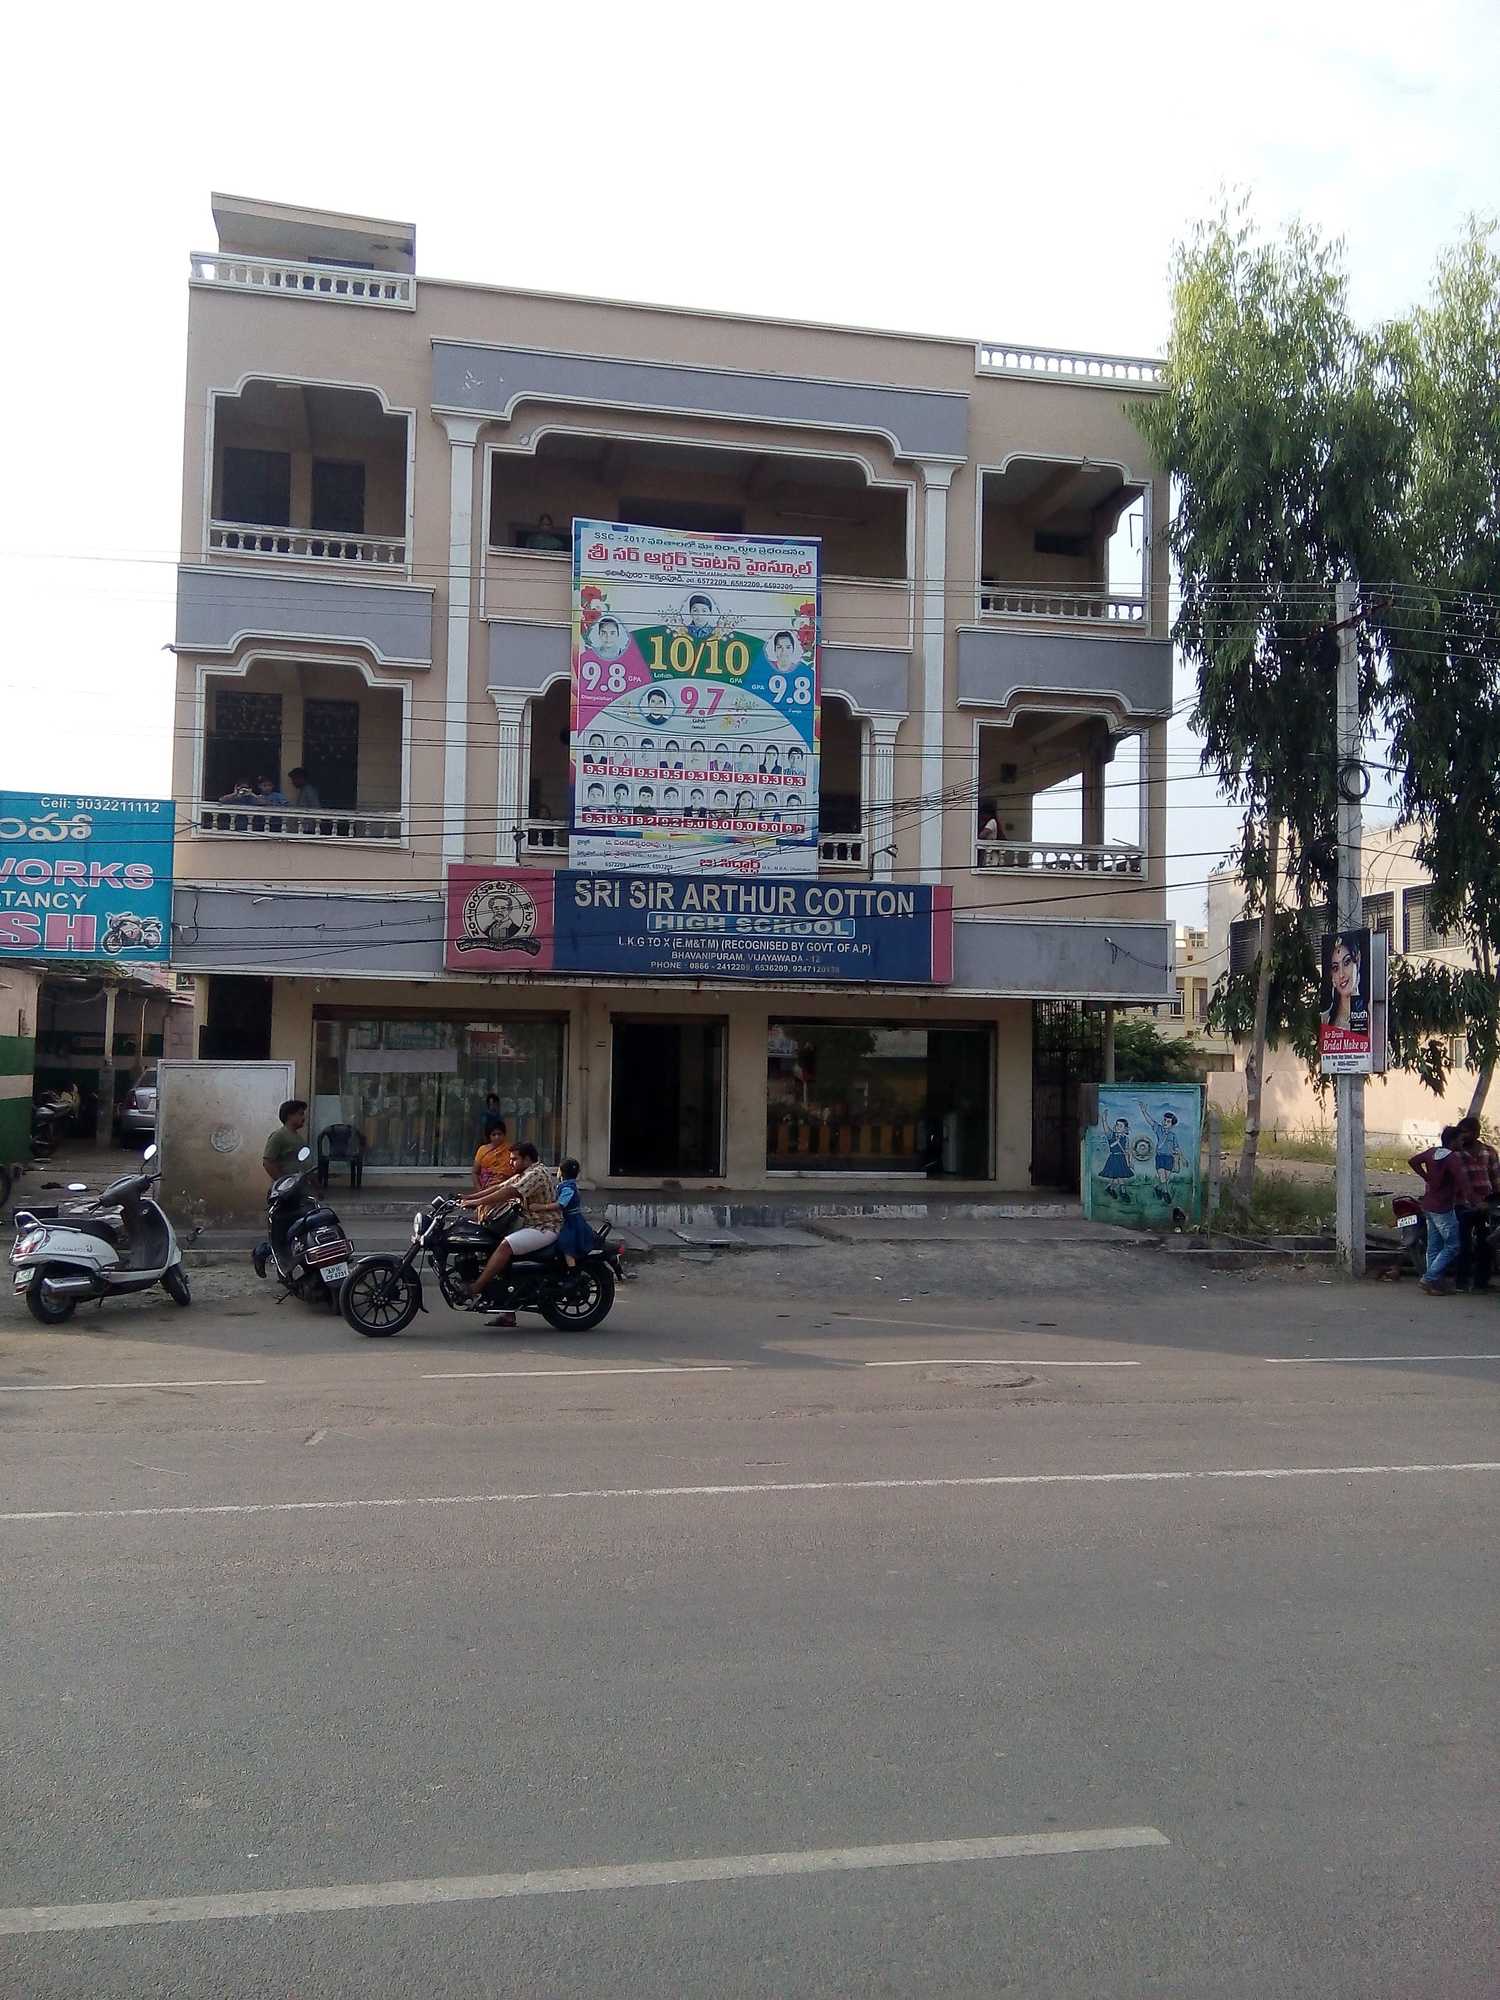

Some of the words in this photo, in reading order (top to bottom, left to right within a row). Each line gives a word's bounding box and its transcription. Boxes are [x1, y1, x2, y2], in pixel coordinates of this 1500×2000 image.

[594, 532, 615, 540] SSC
[624, 535, 646, 543] 2017
[587, 543, 608, 561] శ్రీ
[612, 547, 640, 562] సర్
[691, 556, 740, 571] కాటన్
[649, 634, 750, 677] 10/10
[581, 661, 627, 693] 9.8
[768, 674, 812, 705] 9.8
[680, 686, 725, 716] 9.7
[586, 765, 605, 774] 9.5
[612, 767, 630, 776] 9.5
[638, 769, 656, 777] 9.5
[663, 770, 681, 779] 9.5
[687, 771, 705, 780] 9.3
[713, 773, 730, 781] 9.3
[737, 774, 755, 782] 9.3
[762, 776, 779, 784] 9.3
[786, 777, 804, 786] 9.3
[40, 797, 71, 808] Cell:
[76, 798, 160, 814] 9032211112
[611, 815, 629, 824] 9.3
[711, 821, 729, 829] 9.0
[736, 822, 753, 830] 9.0
[760, 823, 779, 832] 9.0
[0, 890, 88, 909] TANCY
[574, 879, 620, 908] SRI
[629, 880, 675, 910] SIR
[681, 883, 797, 914] ARTHUR
[804, 887, 915, 918] COTTON
[655, 914, 726, 932] HIGH
[735, 917, 850, 936] SCHOOL
[649, 937, 661, 948] TO
[663, 937, 670, 948] X
[721, 938, 789, 952] (RECOGNISED
[791, 942, 805, 951] BY
[837, 943, 851, 953] OF
[651, 961, 681, 969] PHONE
[749, 953, 803, 963] VIJAYAWADA
